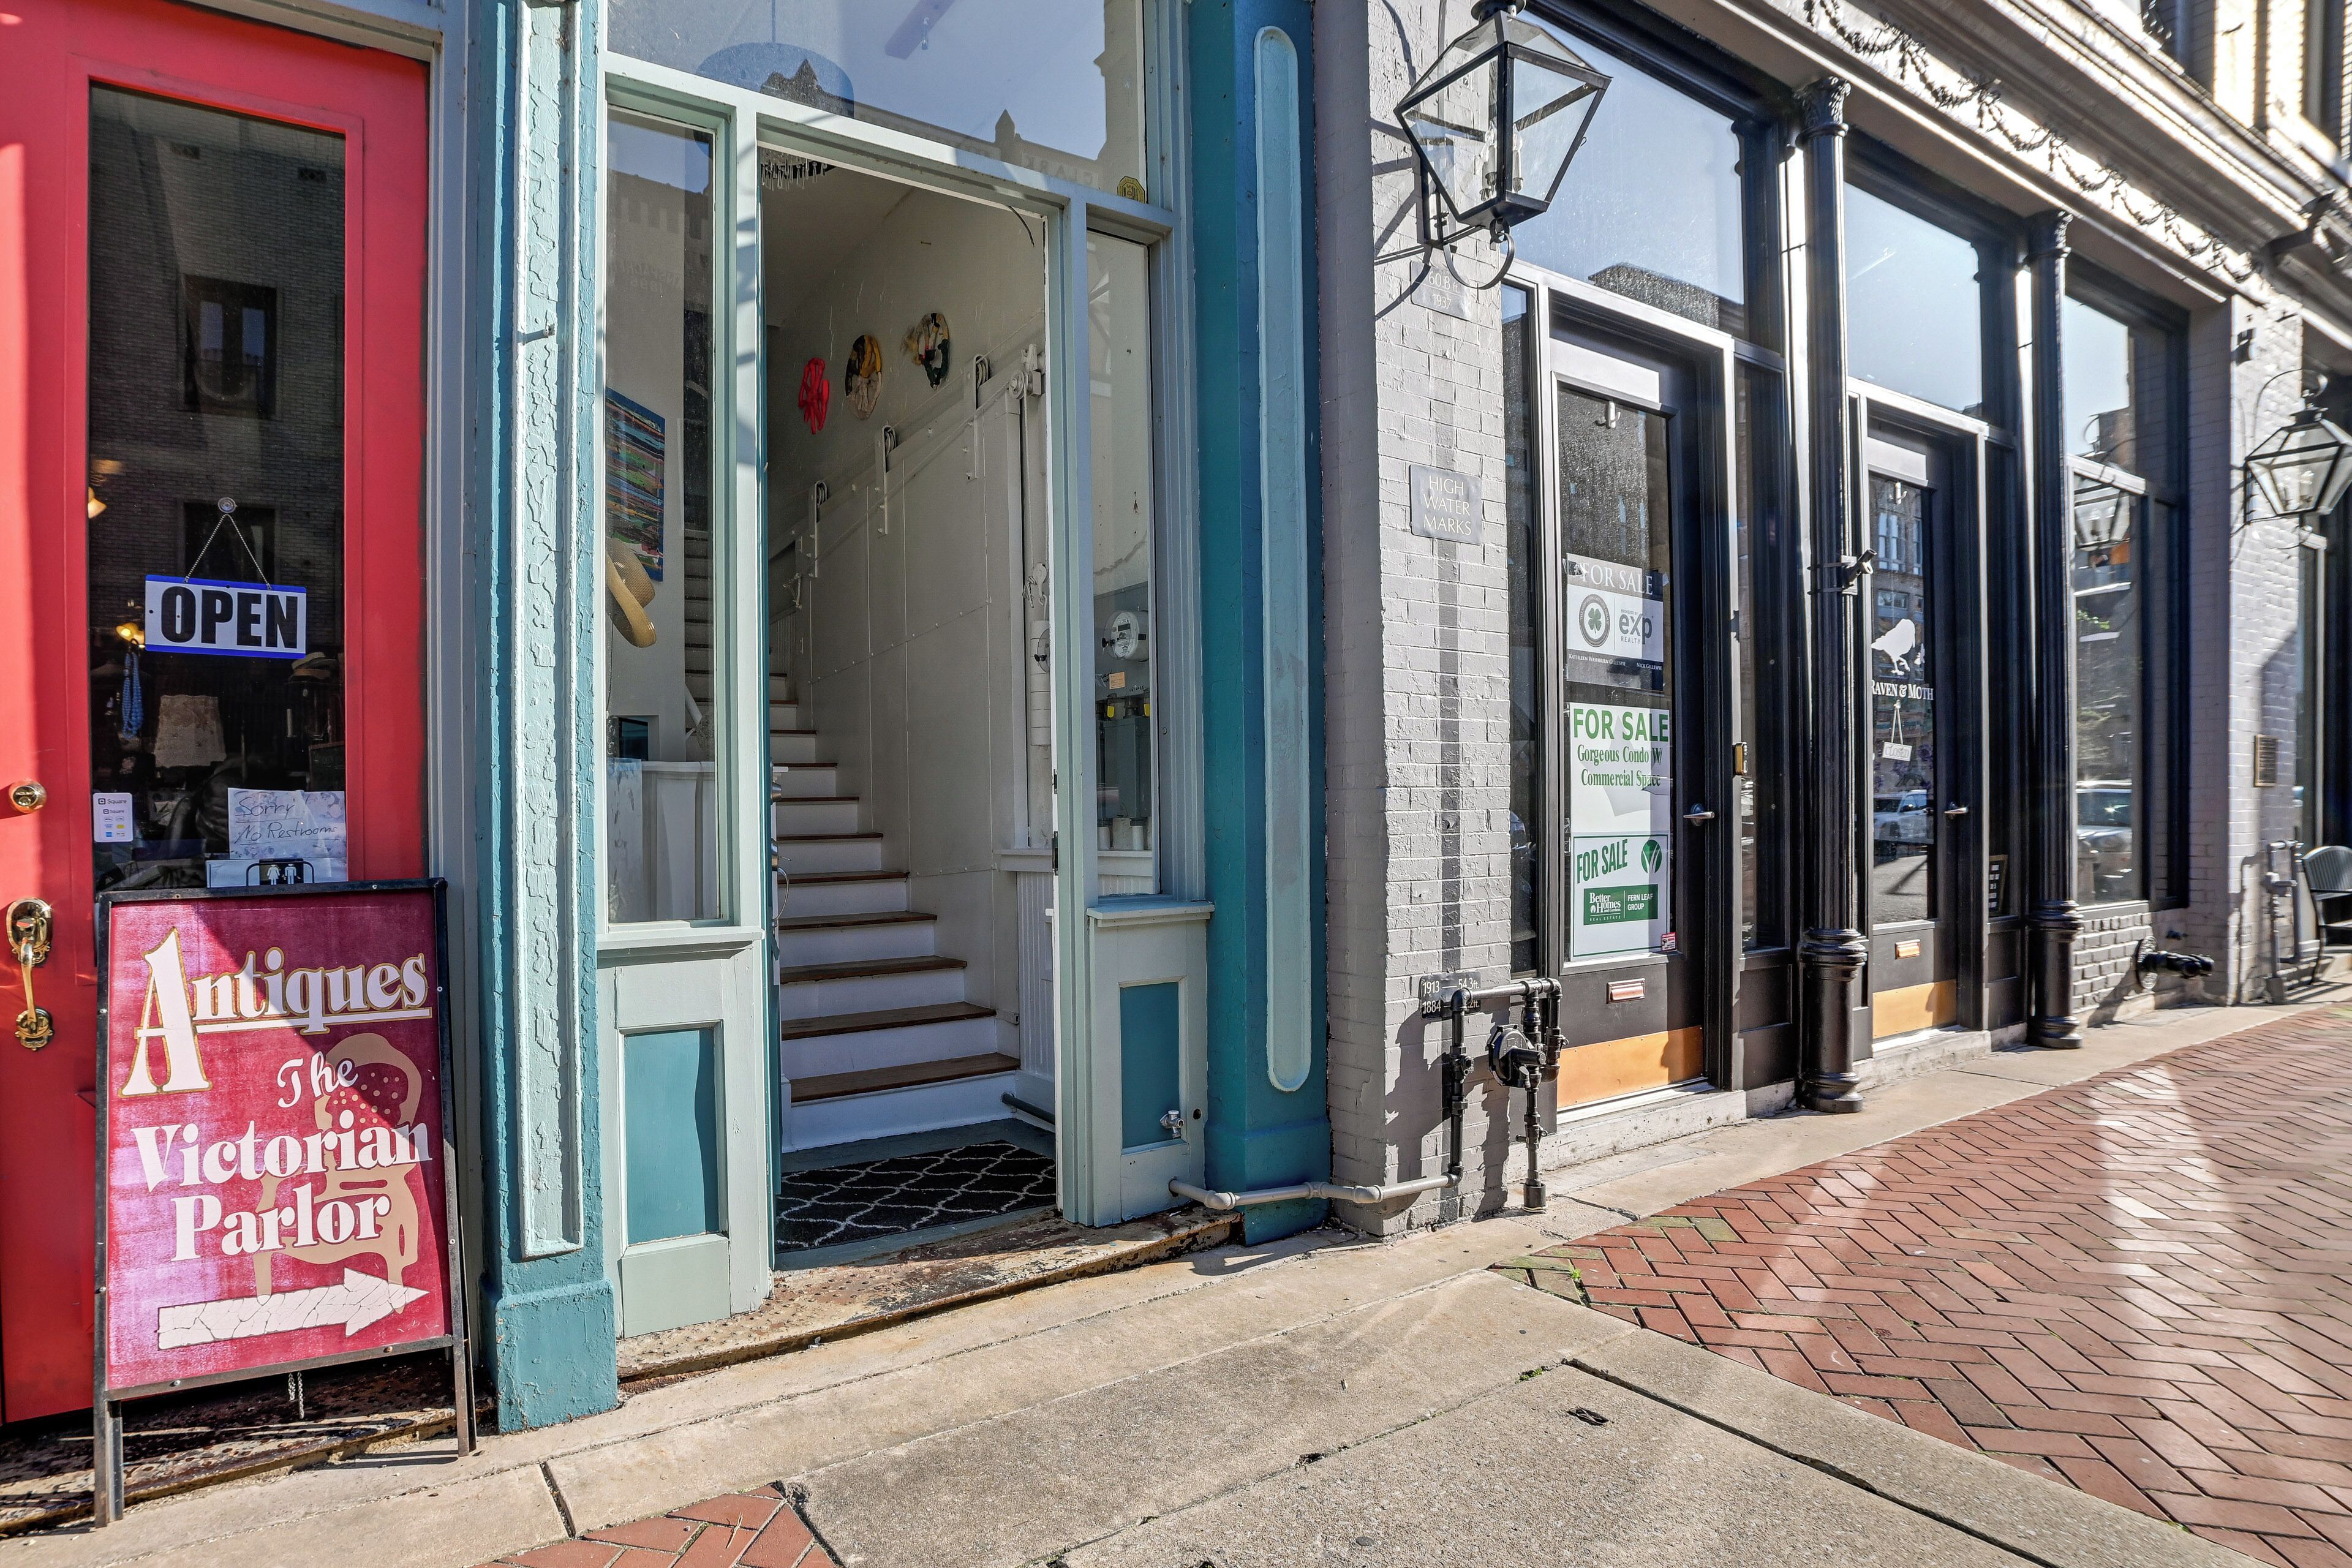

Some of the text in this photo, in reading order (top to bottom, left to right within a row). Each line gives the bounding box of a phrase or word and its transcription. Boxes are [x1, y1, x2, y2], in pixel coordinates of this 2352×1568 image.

[1428, 271, 1450, 290] 60.8
[1432, 293, 1452, 309] 1937
[1429, 475, 1464, 496] HIGH
[1423, 494, 1471, 516] WATER
[1423, 514, 1472, 535] MARKS
[1582, 563, 1653, 595] FOR SALE
[160, 586, 298, 649] OPEN
[1621, 636, 1641, 644] REALTY
[1588, 655, 1608, 664] WASHBURN
[1871, 680, 1934, 700] RAVEN & MOTH
[1574, 708, 1668, 742] FOR SALE
[1577, 744, 1663, 766] Gorgeous Condo W/
[1581, 769, 1661, 790] Commercial Space
[235, 796, 295, 820] Sorry
[234, 821, 337, 844] No Restrooms
[1577, 839, 1628, 884] FOR SALE
[1589, 892, 1611, 903] Better
[1596, 901, 1621, 913] Homes
[1422, 977, 1480, 994] 1913 54.3ft.
[118, 926, 433, 1098] Antiques
[1422, 1000, 1441, 1014] 1884
[276, 1051, 359, 1109] The
[130, 1109, 433, 1193] Victorian
[171, 1182, 393, 1262] Parlor
